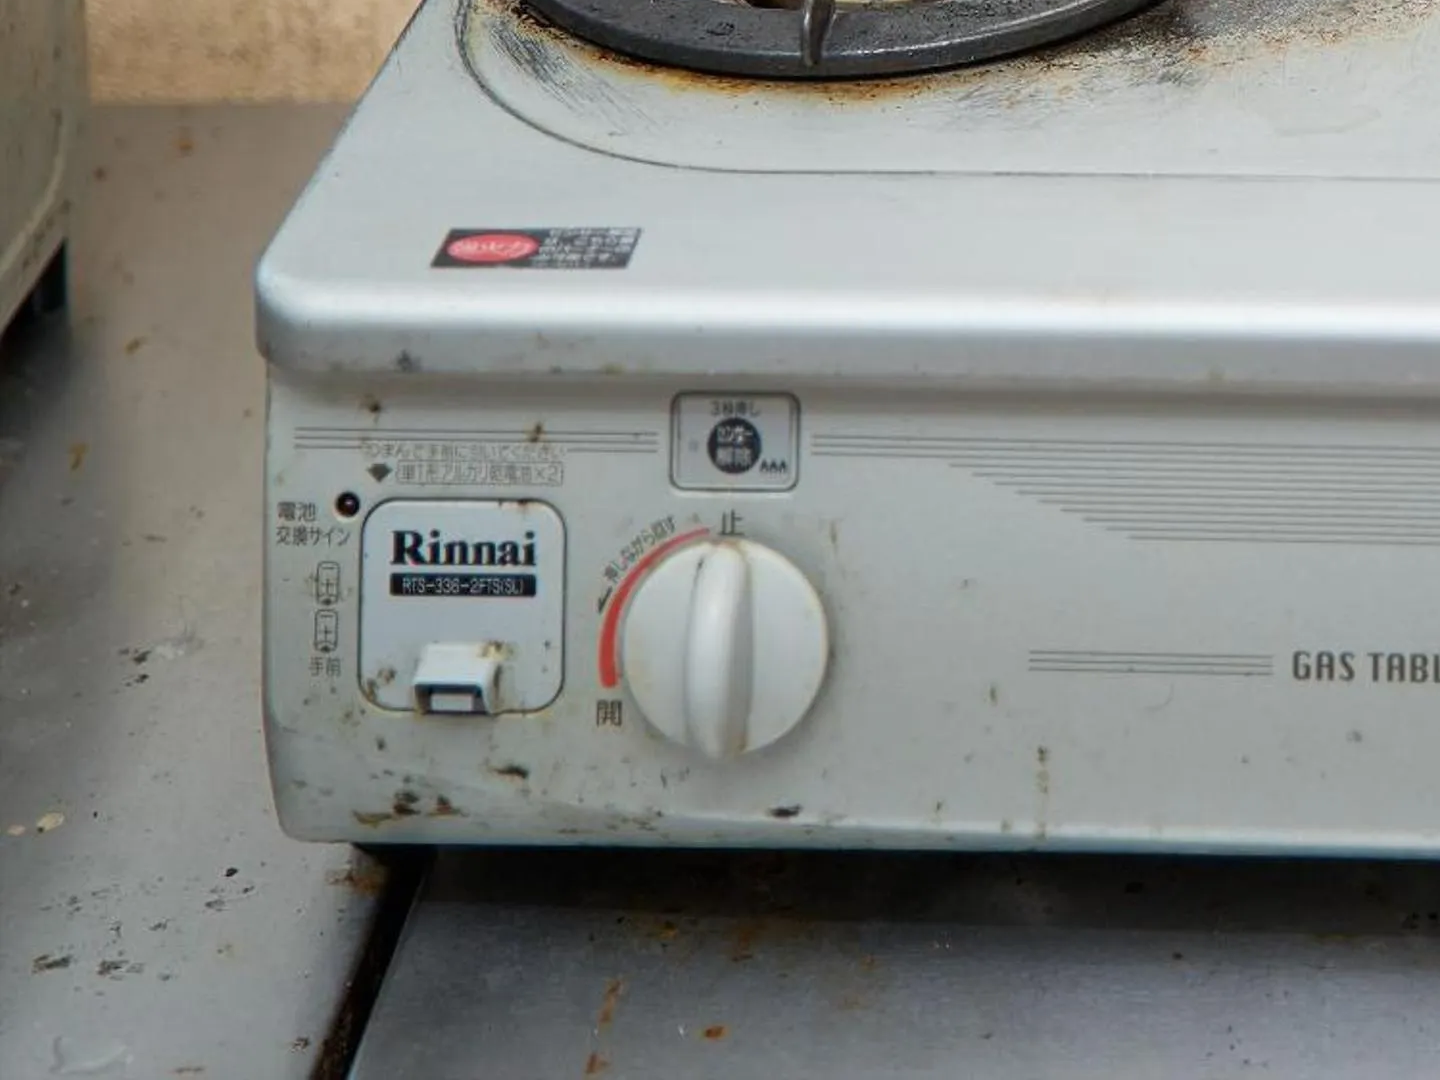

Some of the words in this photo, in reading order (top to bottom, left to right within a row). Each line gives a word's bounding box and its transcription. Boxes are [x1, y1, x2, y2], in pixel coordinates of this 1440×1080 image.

[277, 501, 316, 522] 電池
[717, 508, 746, 536] 止
[276, 526, 351, 548] 交換サイン
[390, 529, 536, 566] Rinnai
[1292, 650, 1355, 682] GAS
